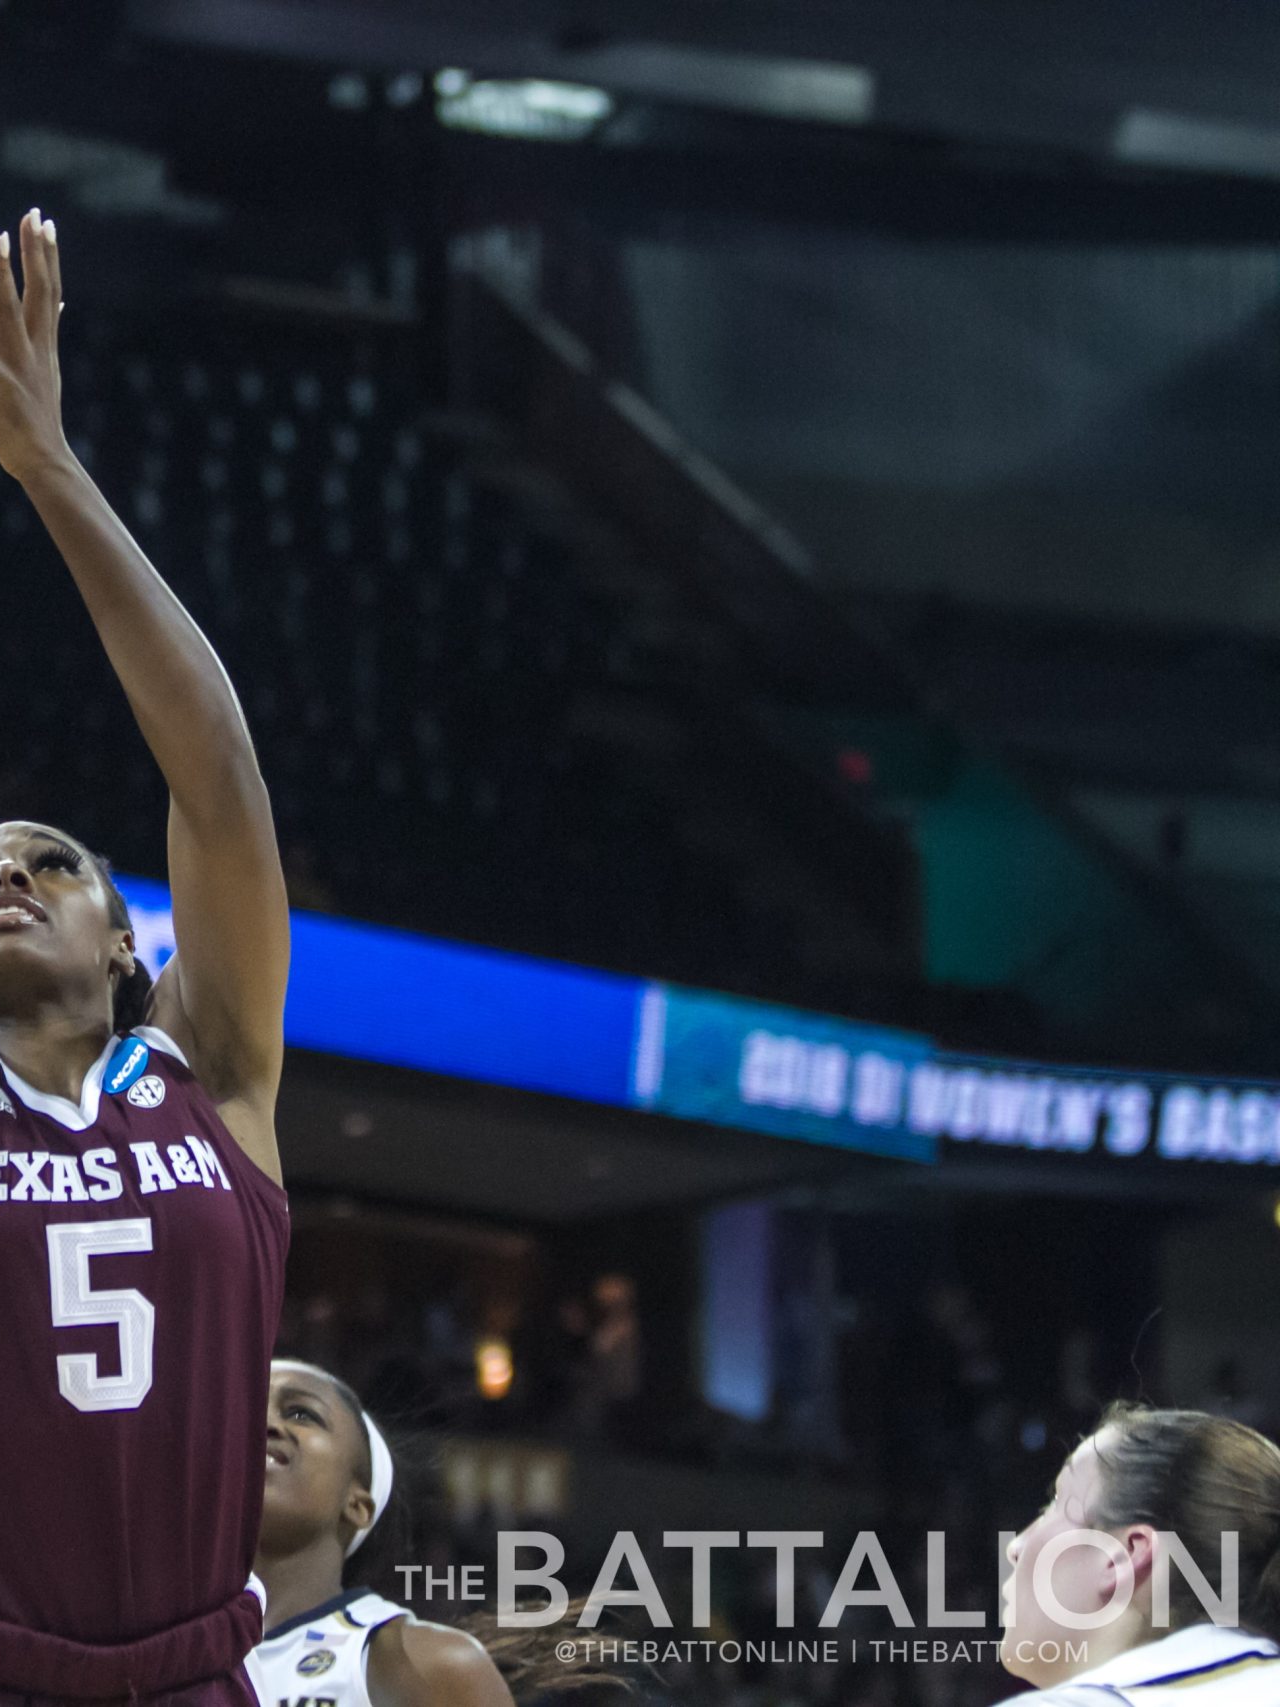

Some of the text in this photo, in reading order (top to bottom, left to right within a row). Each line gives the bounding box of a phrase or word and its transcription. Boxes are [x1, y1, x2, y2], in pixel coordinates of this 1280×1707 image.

[111, 1044, 147, 1090] NCAA
[129, 1077, 164, 1106] SEC
[1160, 1083, 1280, 1165] BAS
[129, 1135, 233, 1195] A&M
[45, 1217, 156, 1412] 5
